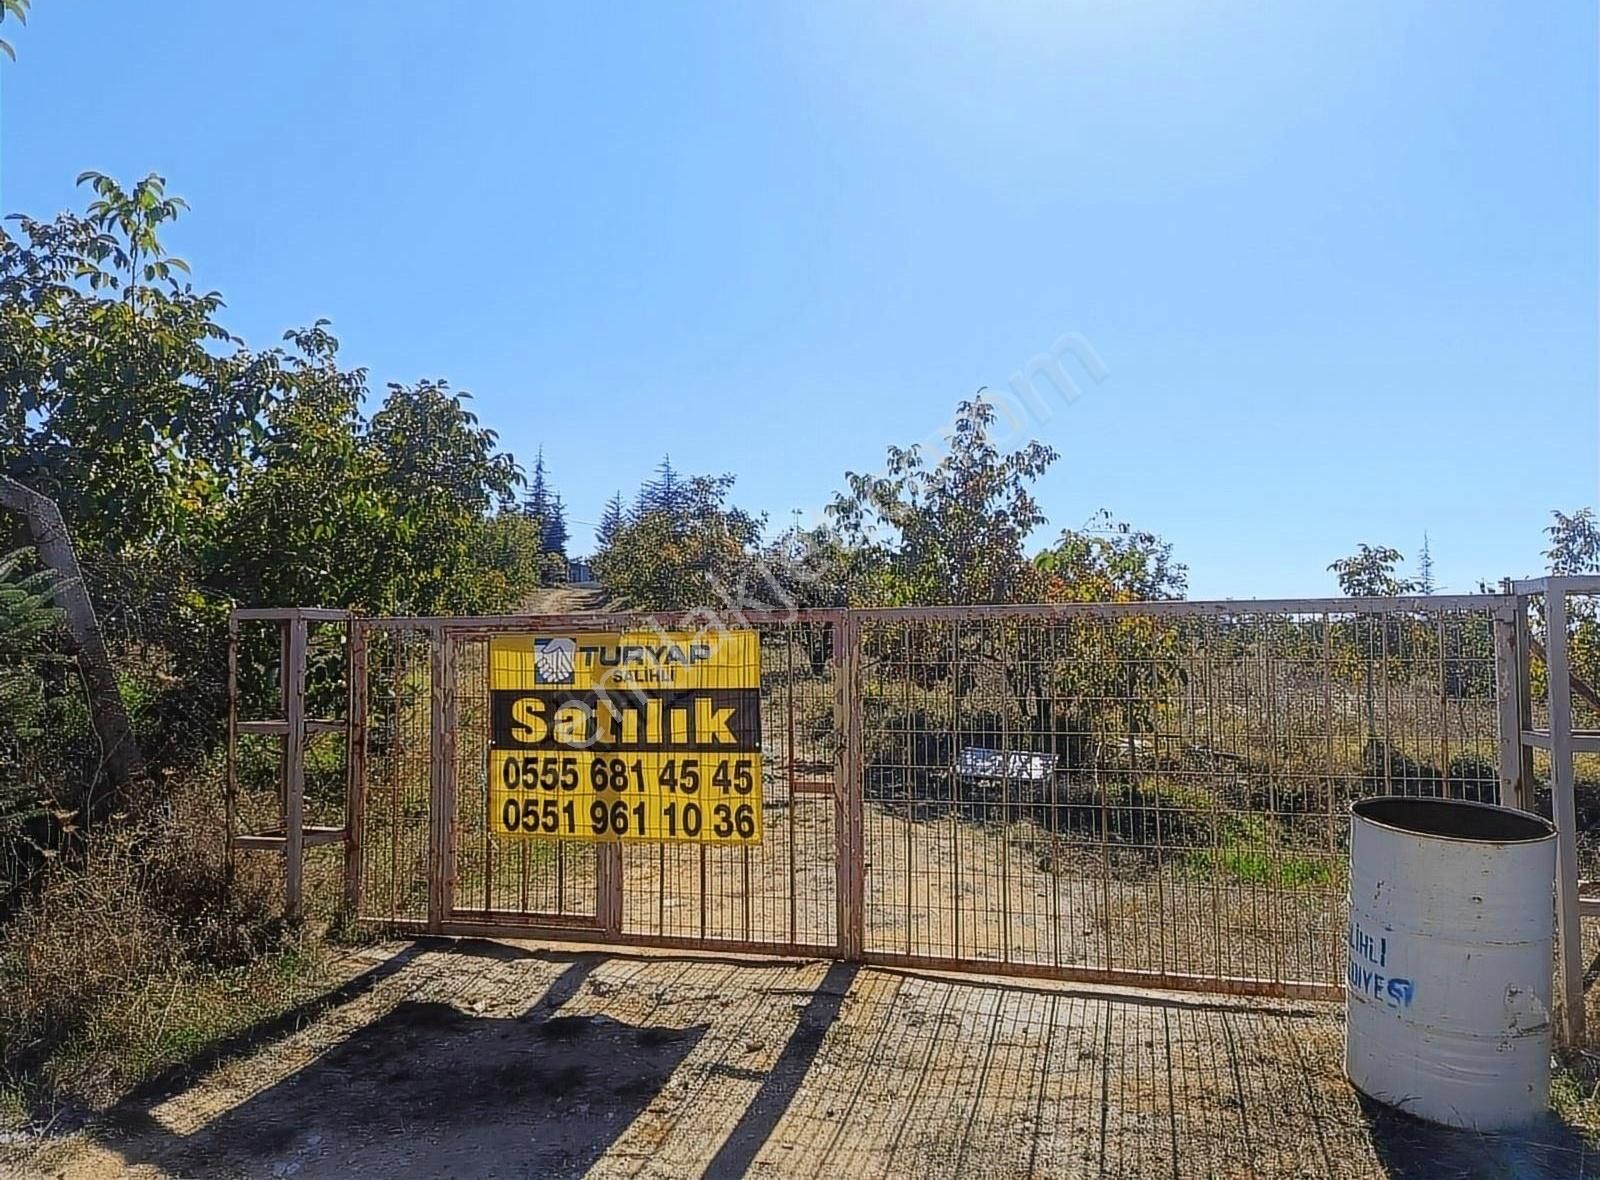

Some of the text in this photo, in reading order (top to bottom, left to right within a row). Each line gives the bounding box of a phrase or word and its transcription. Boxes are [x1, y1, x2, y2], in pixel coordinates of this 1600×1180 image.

[578, 644, 711, 666] TURYAP
[503, 757, 754, 795] 0555 681 45 45
[503, 799, 755, 838] 0551 961 10 36
